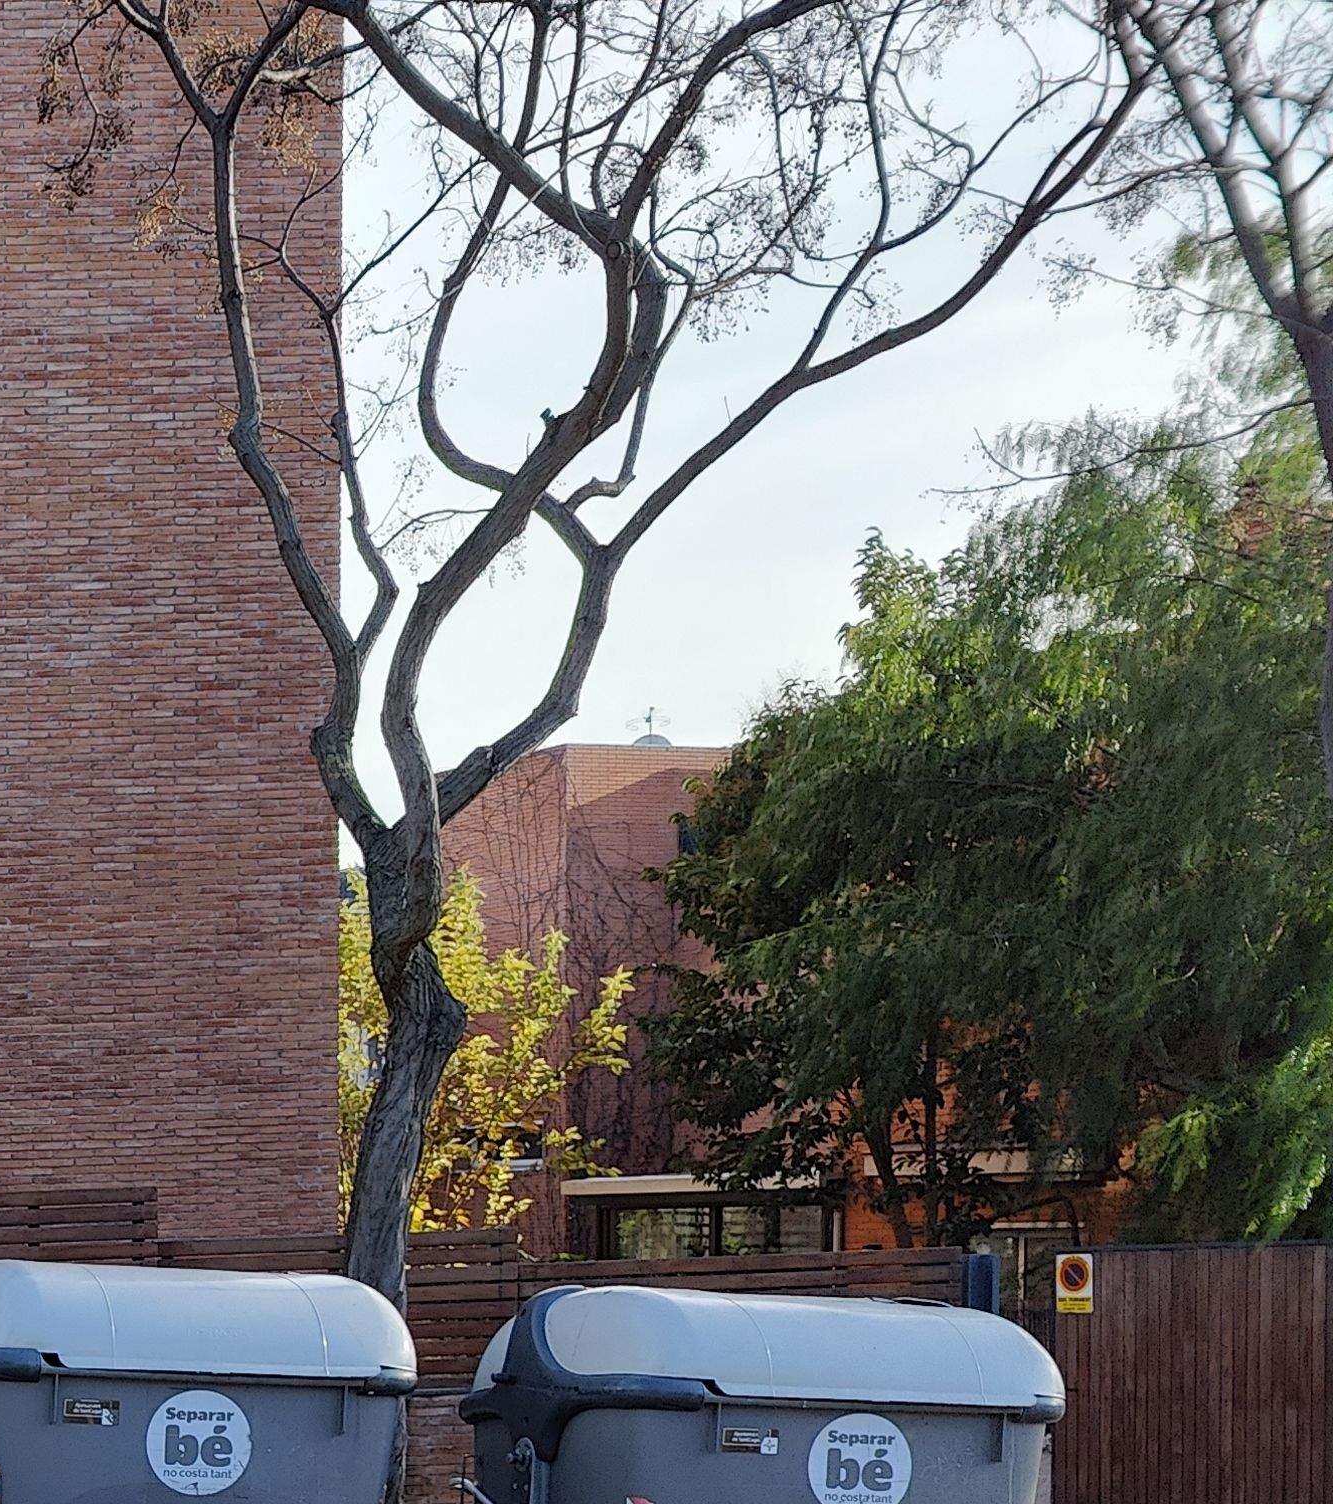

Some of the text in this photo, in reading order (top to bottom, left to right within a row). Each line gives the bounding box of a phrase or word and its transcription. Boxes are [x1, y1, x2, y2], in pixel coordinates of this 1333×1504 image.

[165, 1407, 235, 1423] Separar
[164, 1424, 233, 1468] bé
[827, 1430, 896, 1447] Separar
[163, 1469, 233, 1479] no costa tant
[825, 1448, 893, 1492] bé
[824, 1493, 893, 1504] no costa tant
